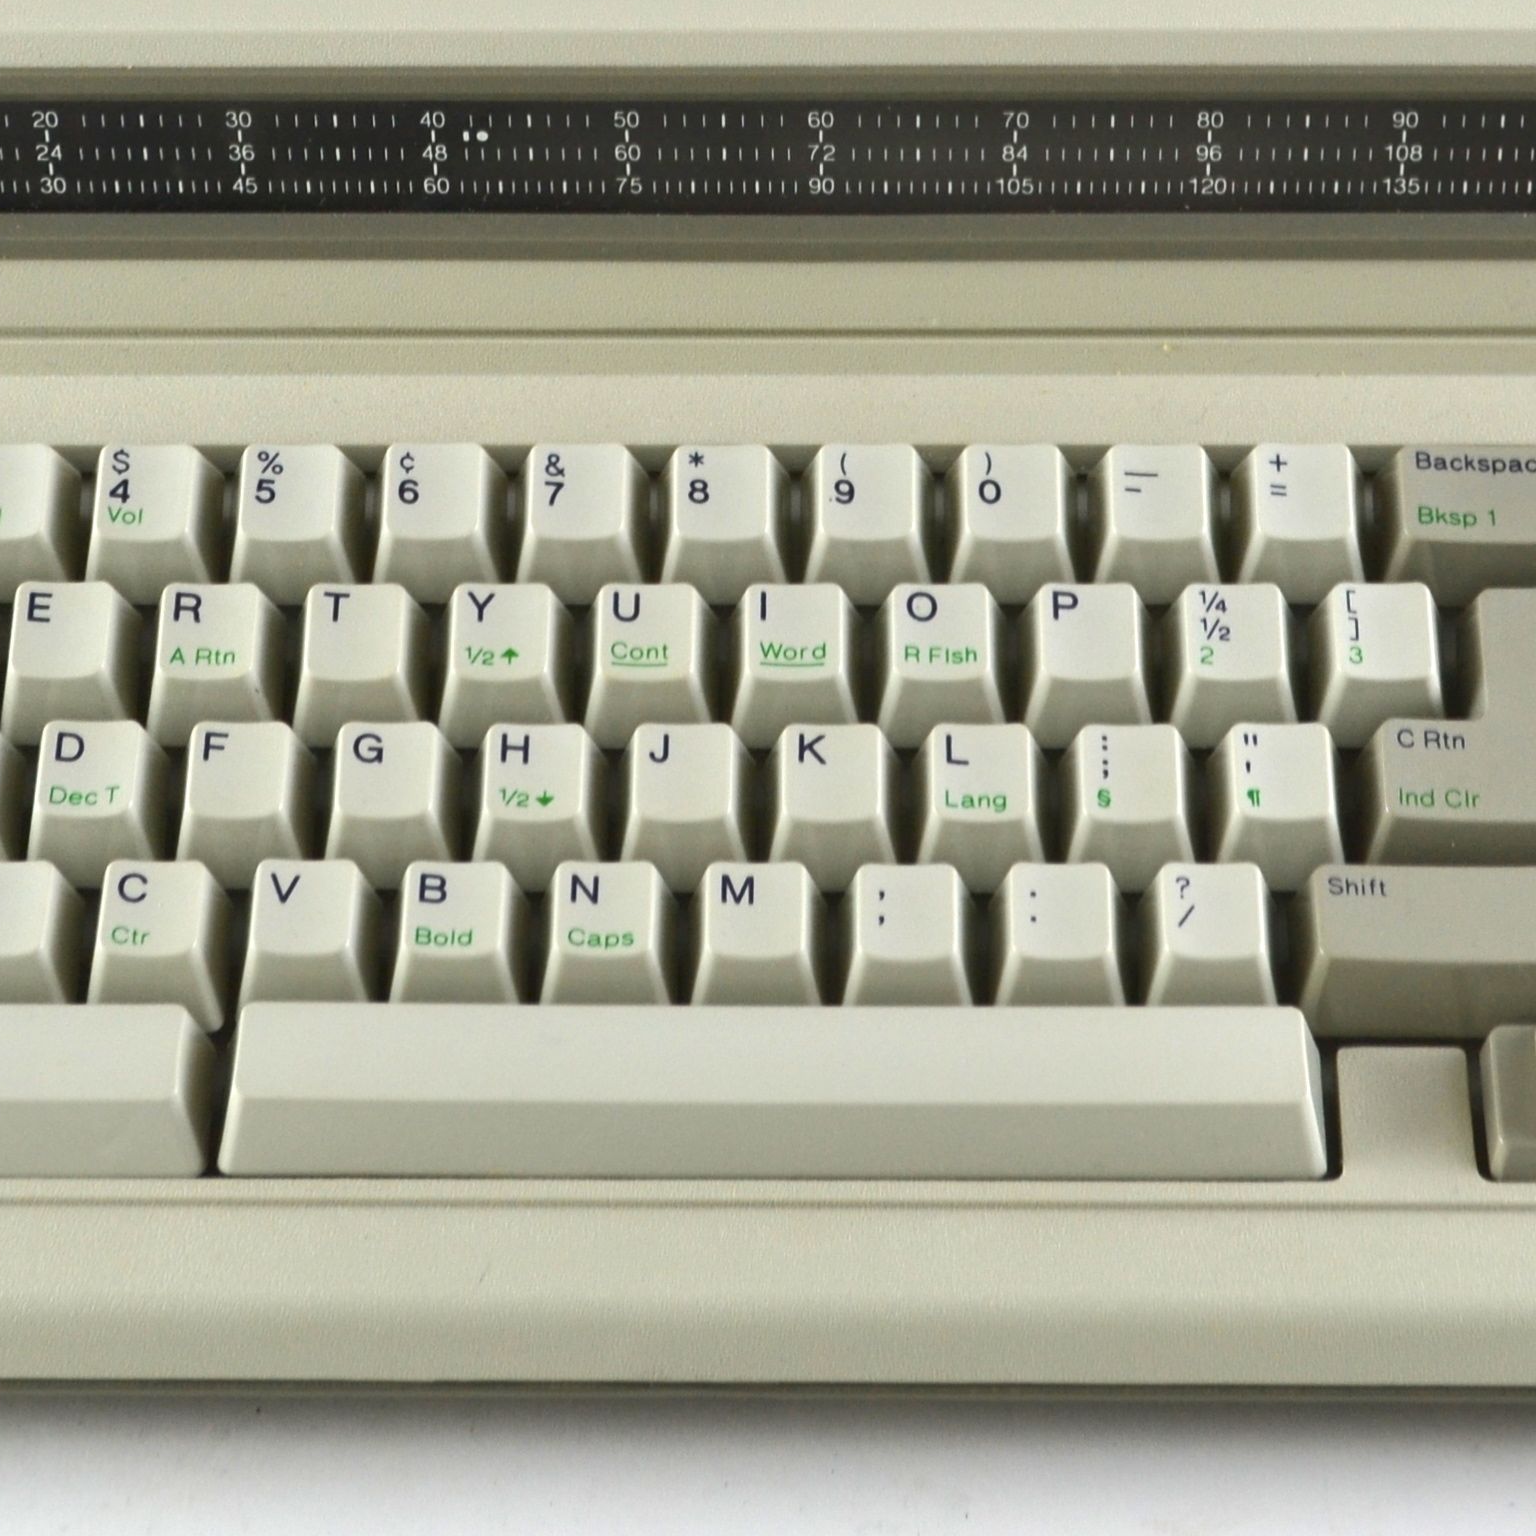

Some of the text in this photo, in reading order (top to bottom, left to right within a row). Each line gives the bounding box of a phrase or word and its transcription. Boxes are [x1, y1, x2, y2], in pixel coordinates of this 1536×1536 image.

[32, 111, 59, 128] 20
[225, 111, 252, 128] 30
[420, 111, 446, 129] 40
[613, 111, 640, 129] 50
[807, 111, 834, 129] 60
[1004, 111, 1030, 129] 70
[1196, 111, 1224, 129] 80
[1392, 111, 1419, 128] 90
[35, 144, 62, 161] 24
[228, 144, 255, 161] 36
[422, 144, 448, 161] 48
[614, 144, 641, 161] 60
[808, 144, 836, 162] 72
[1001, 145, 1028, 162] 84
[1196, 144, 1222, 162] 96
[1385, 144, 1423, 162] 108
[40, 176, 67, 194] 30
[232, 177, 258, 194] 45
[423, 177, 450, 194] 60
[616, 177, 643, 195] 75
[808, 177, 835, 194] 90
[996, 177, 1034, 195] 105
[1189, 177, 1227, 195] 120
[1383, 177, 1420, 195] 135
[111, 448, 131, 476] $
[257, 450, 284, 475] %
[544, 453, 566, 478] &
[108, 478, 130, 504] 4
[254, 478, 276, 504] 5
[398, 478, 420, 505] 6
[544, 480, 565, 507] 7
[687, 478, 710, 505] 8
[834, 479, 855, 505] 9
[978, 479, 1002, 505] 0
[107, 505, 143, 525] Vol
[1417, 505, 1496, 529] Bksp 1
[27, 591, 53, 623] E
[173, 591, 202, 624] R
[323, 591, 351, 623] T
[467, 591, 495, 623] Y
[612, 591, 641, 623] U
[906, 591, 938, 623] O
[1052, 590, 1079, 621] P
[169, 646, 236, 666] A Rtn
[610, 641, 668, 662] Cont
[759, 641, 827, 662] Word
[904, 645, 921, 663] R
[1199, 645, 1215, 666] 2
[1349, 645, 1364, 665] 3
[54, 731, 85, 763] D
[202, 731, 229, 762] F
[352, 733, 384, 764] G
[500, 732, 530, 765] H
[648, 733, 670, 764] J
[798, 733, 826, 765] K
[945, 734, 969, 766] L
[1396, 727, 1466, 750] C Rtn
[48, 785, 120, 806] Dec T
[944, 789, 1008, 814] Lang
[1399, 787, 1480, 809] Ind Clr
[117, 872, 148, 904] C
[270, 872, 301, 904] V
[418, 873, 447, 904] B
[570, 874, 600, 905] N
[721, 874, 755, 905] M
[1175, 876, 1191, 900] ?
[1327, 877, 1386, 897] Shift
[110, 925, 150, 946] Ctr
[414, 926, 473, 947] Bold
[567, 927, 635, 950] Caps
